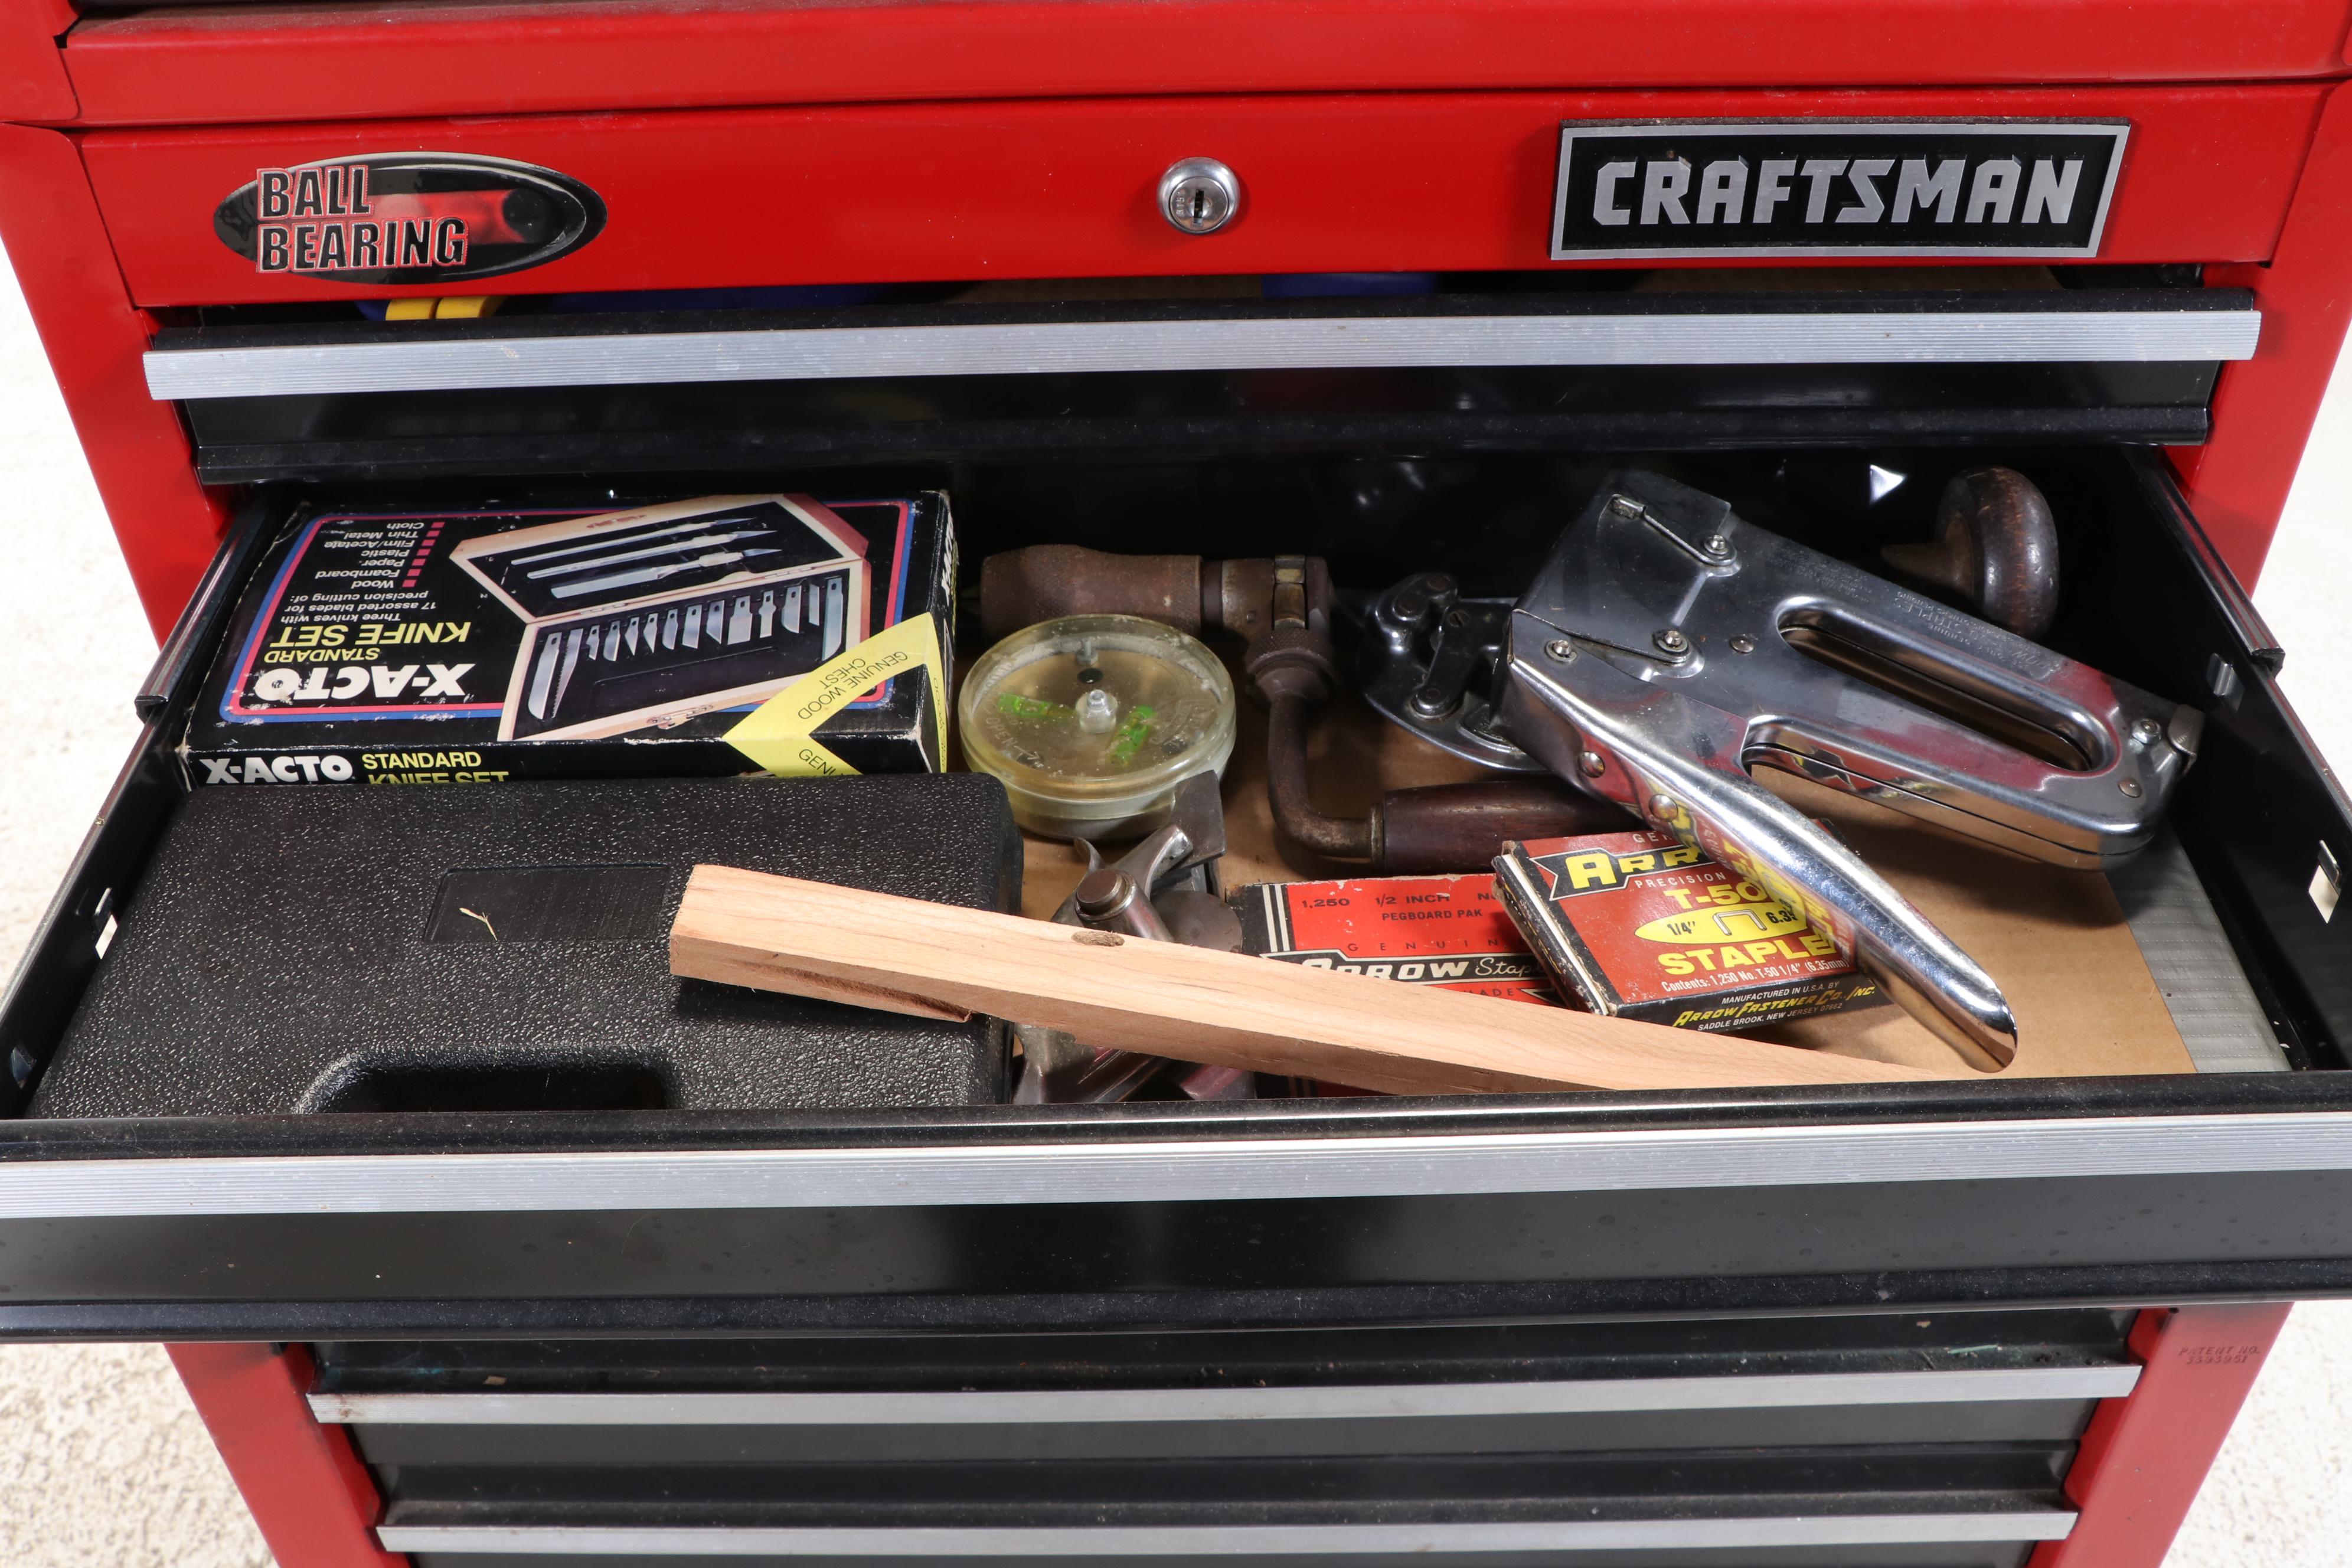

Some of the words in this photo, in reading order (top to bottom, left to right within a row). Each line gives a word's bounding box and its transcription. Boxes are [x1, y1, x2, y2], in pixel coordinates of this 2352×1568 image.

[257, 165, 373, 219] BALL
[1592, 156, 2084, 226] CRAFTSMAN
[257, 217, 470, 273] BEARING
[386, 522, 424, 530] Cloth
[343, 531, 384, 540] Metal
[324, 540, 416, 549] Film/Acetate
[360, 549, 410, 557] Plastic
[314, 569, 400, 579] Foamboard
[351, 580, 394, 589] Wood
[290, 594, 309, 603] of:
[312, 592, 360, 602] cutting
[364, 590, 429, 600] precision
[284, 603, 305, 613] for
[308, 602, 354, 612] blades
[357, 601, 419, 612] assorted
[421, 601, 437, 610] 17
[280, 615, 311, 624] with
[313, 613, 359, 623] knives
[361, 613, 401, 622] Three
[269, 625, 349, 648] SET
[354, 622, 472, 645] KNIFE
[263, 648, 381, 664] STANDARD
[819, 658, 867, 690] CHEST
[842, 651, 909, 689] GENUINE
[254, 663, 476, 701] X-ACTO
[797, 686, 847, 720] WOOD
[362, 751, 482, 770] STANDARD
[198, 754, 354, 785] X-ACTO
[1564, 847, 1700, 890] ARR
[1634, 871, 1727, 888] PRECISION
[1302, 897, 1350, 909] 1,250
[1375, 893, 1397, 907] 1/2
[1406, 893, 1451, 904] INCH
[1662, 881, 1768, 910] T-50
[1381, 909, 1452, 921] PEGBOARD
[1457, 908, 1484, 919] PAK
[1347, 939, 1523, 952] GENUIN
[1657, 932, 1837, 975] STAPLE
[1661, 978, 1710, 992] Contents:
[1709, 971, 1739, 986] 1,250
[1740, 970, 1757, 982] No.
[1804, 958, 1850, 973] (6.35mm)
[1721, 988, 1789, 1005] MANUFACTURED
[1802, 984, 1826, 993] U.S.A.
[1828, 981, 1840, 989] BY
[1672, 1006, 1739, 1028] ARROW
[1734, 994, 1818, 1018] FASTENER
[1697, 1020, 1732, 1031] SADDLE
[1766, 1011, 1786, 1021] NEW
[1787, 1007, 1819, 1018] JERSEY
[2177, 1346, 2235, 1356] PATENT
